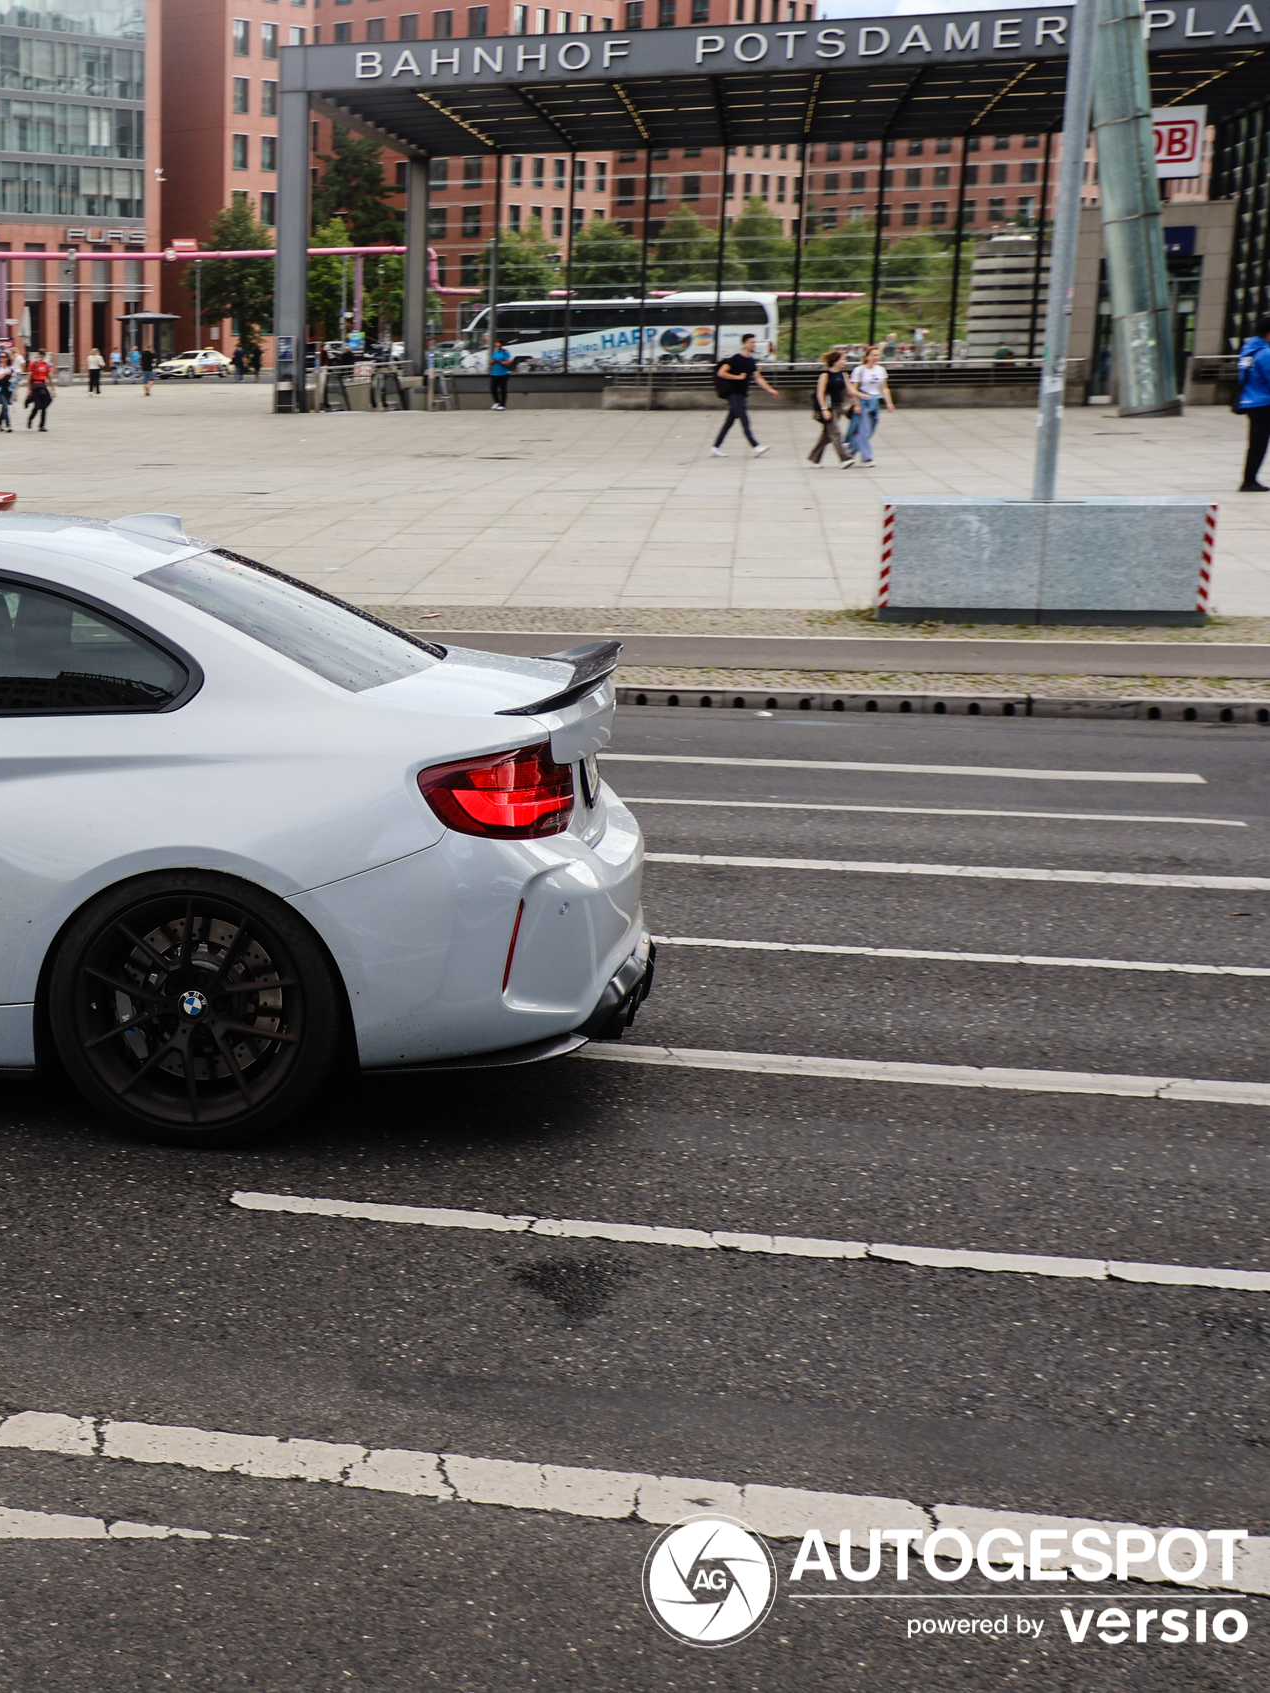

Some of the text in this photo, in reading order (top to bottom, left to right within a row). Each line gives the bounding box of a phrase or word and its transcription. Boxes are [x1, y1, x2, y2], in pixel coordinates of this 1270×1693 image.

[355, 3, 1263, 79] BAHNHOF POTSDAMER PLA
[600, 327, 658, 350] HAPP
